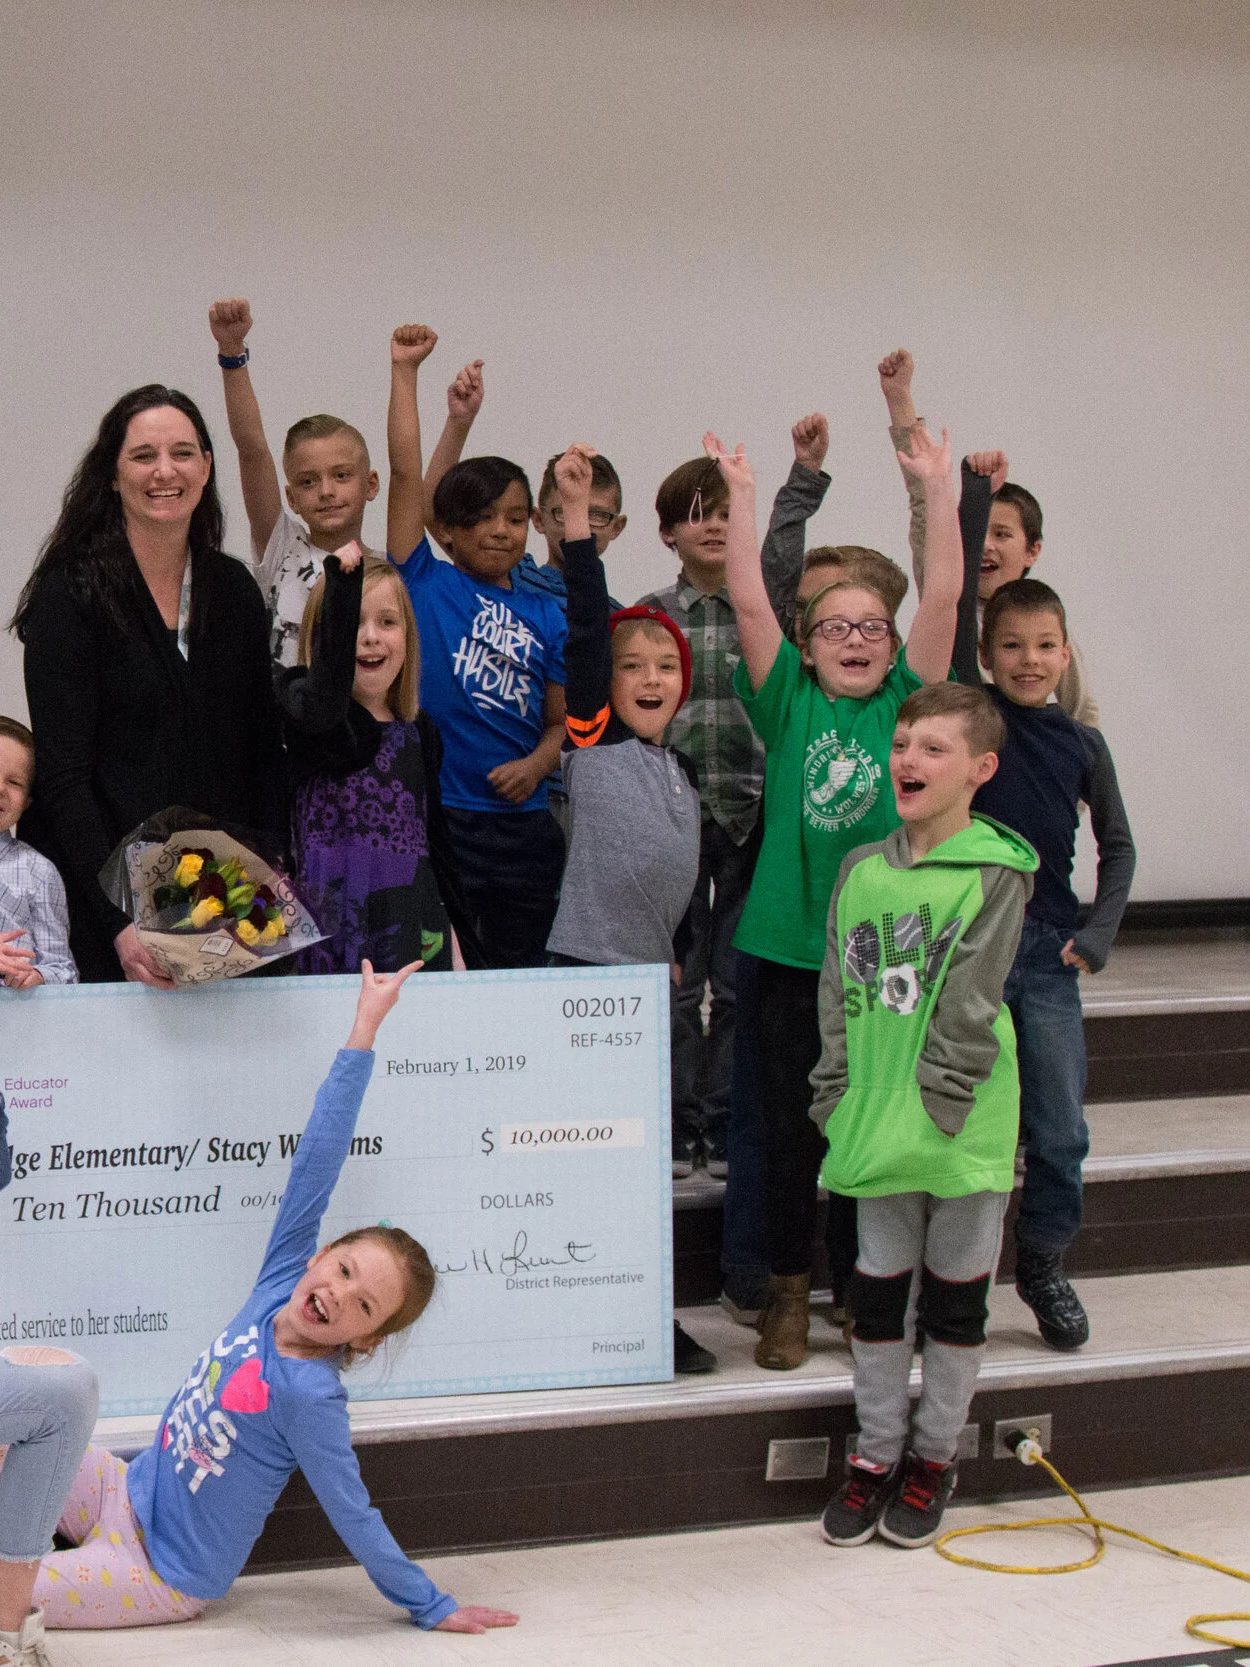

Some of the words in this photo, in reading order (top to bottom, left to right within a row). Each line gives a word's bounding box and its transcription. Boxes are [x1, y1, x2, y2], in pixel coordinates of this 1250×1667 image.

[471, 610, 545, 669] COURT
[452, 636, 531, 717] HUSTLE
[561, 996, 642, 1019] 002017
[570, 1031, 643, 1048] REF-4557
[386, 1058, 459, 1077] February
[464, 1057, 480, 1074] 1,
[485, 1055, 527, 1072] 2019
[4, 1077, 69, 1091] Educator
[9, 1095, 53, 1109] Award
[481, 1127, 495, 1157] $
[510, 1126, 614, 1148] 10,000.00
[48, 1138, 201, 1172] Elementary/
[207, 1136, 272, 1167] Stacy
[12, 1196, 67, 1222] Ten
[76, 1185, 222, 1219] Thousand
[480, 1192, 554, 1210] DOLLARS
[505, 1277, 550, 1290] District
[553, 1271, 645, 1289] Representative
[21, 1312, 67, 1339] service
[70, 1316, 84, 1336] to
[87, 1308, 110, 1336] her
[113, 1306, 168, 1333] students
[592, 1338, 645, 1354] Principal
